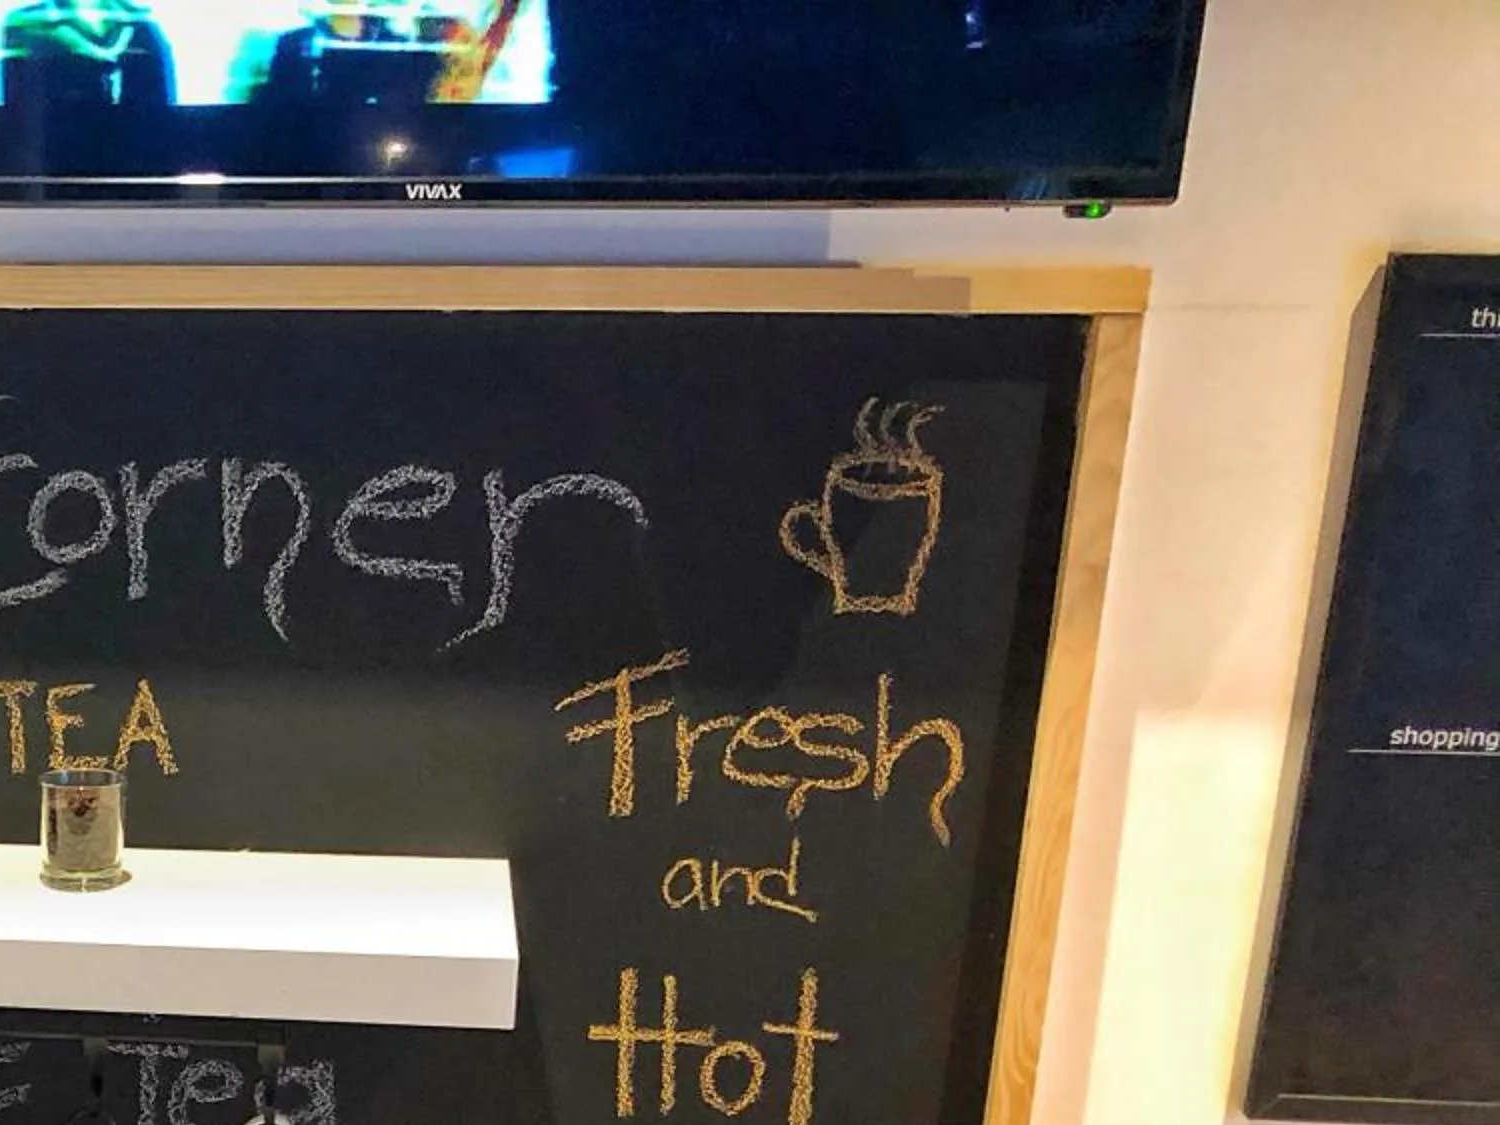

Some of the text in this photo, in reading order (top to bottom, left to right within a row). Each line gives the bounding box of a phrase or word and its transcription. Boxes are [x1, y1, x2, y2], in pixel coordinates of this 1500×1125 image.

[405, 183, 462, 199] VIVAX
[554, 648, 965, 848] Fresh
[1389, 726, 1500, 751] shopping
[661, 836, 818, 922] and
